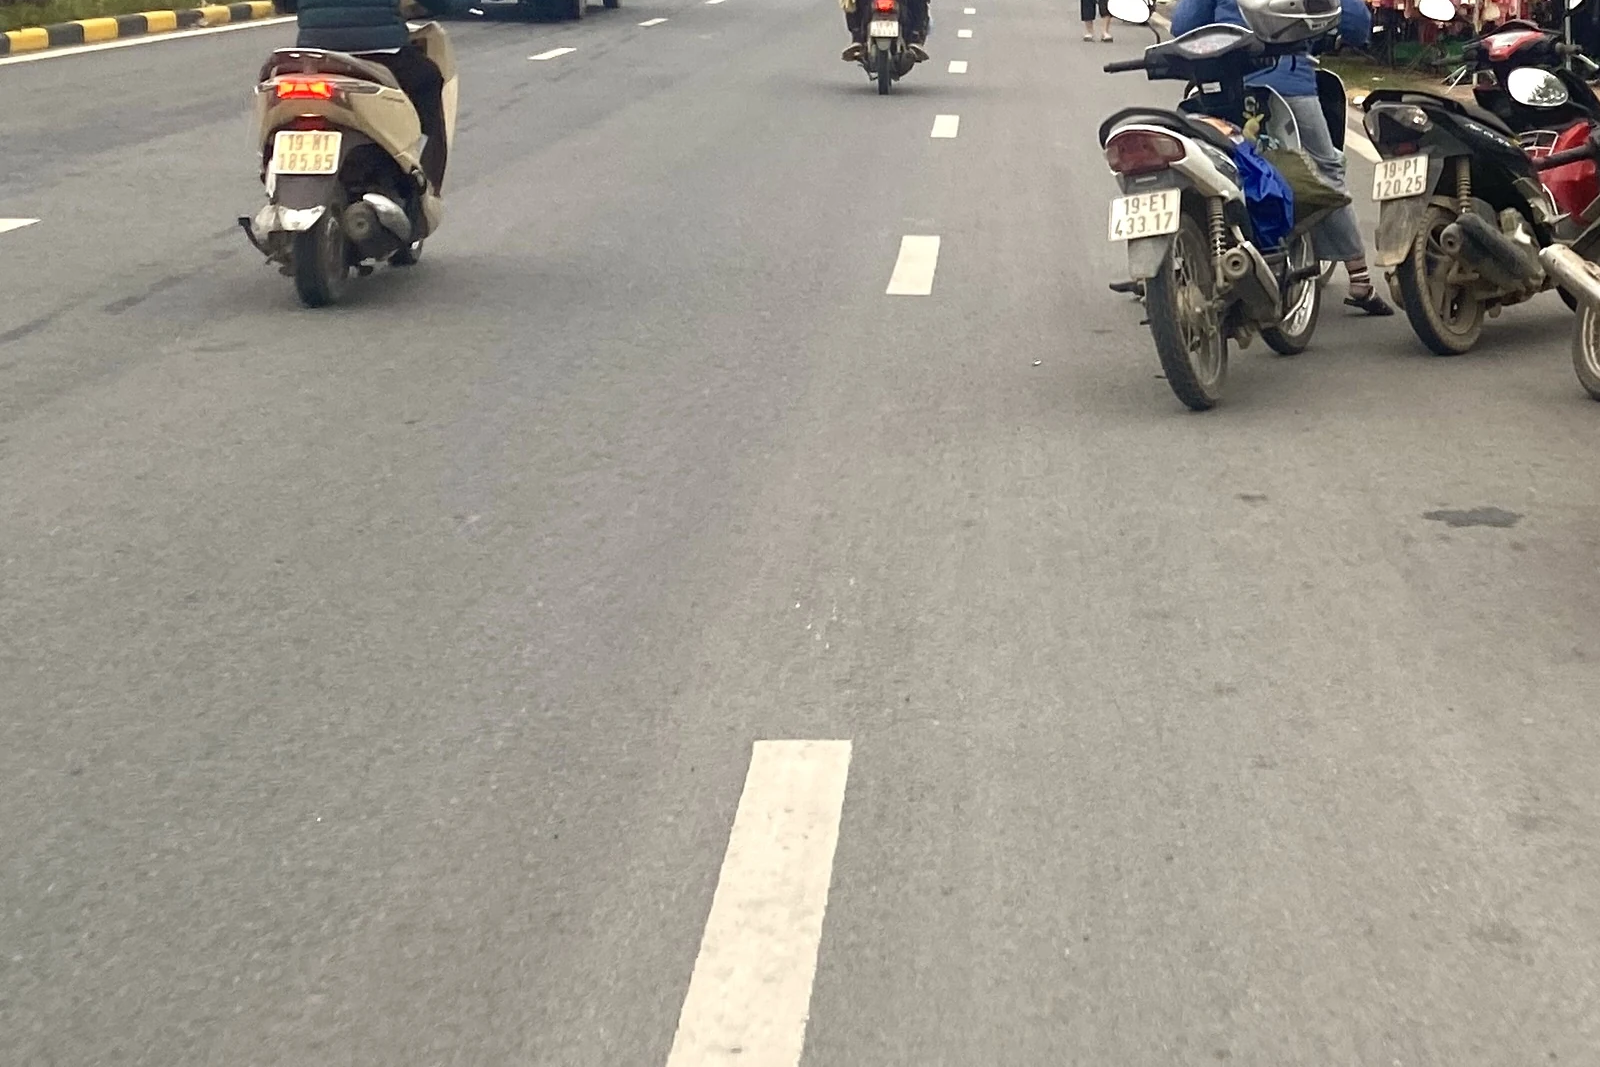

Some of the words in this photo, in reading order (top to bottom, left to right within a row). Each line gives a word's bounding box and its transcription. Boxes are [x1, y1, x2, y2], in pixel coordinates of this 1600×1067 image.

[1383, 157, 1418, 180] 19-P1
[1376, 175, 1423, 198] 120.25
[1124, 192, 1168, 216] 19-E1
[1115, 211, 1173, 237] 433.17
